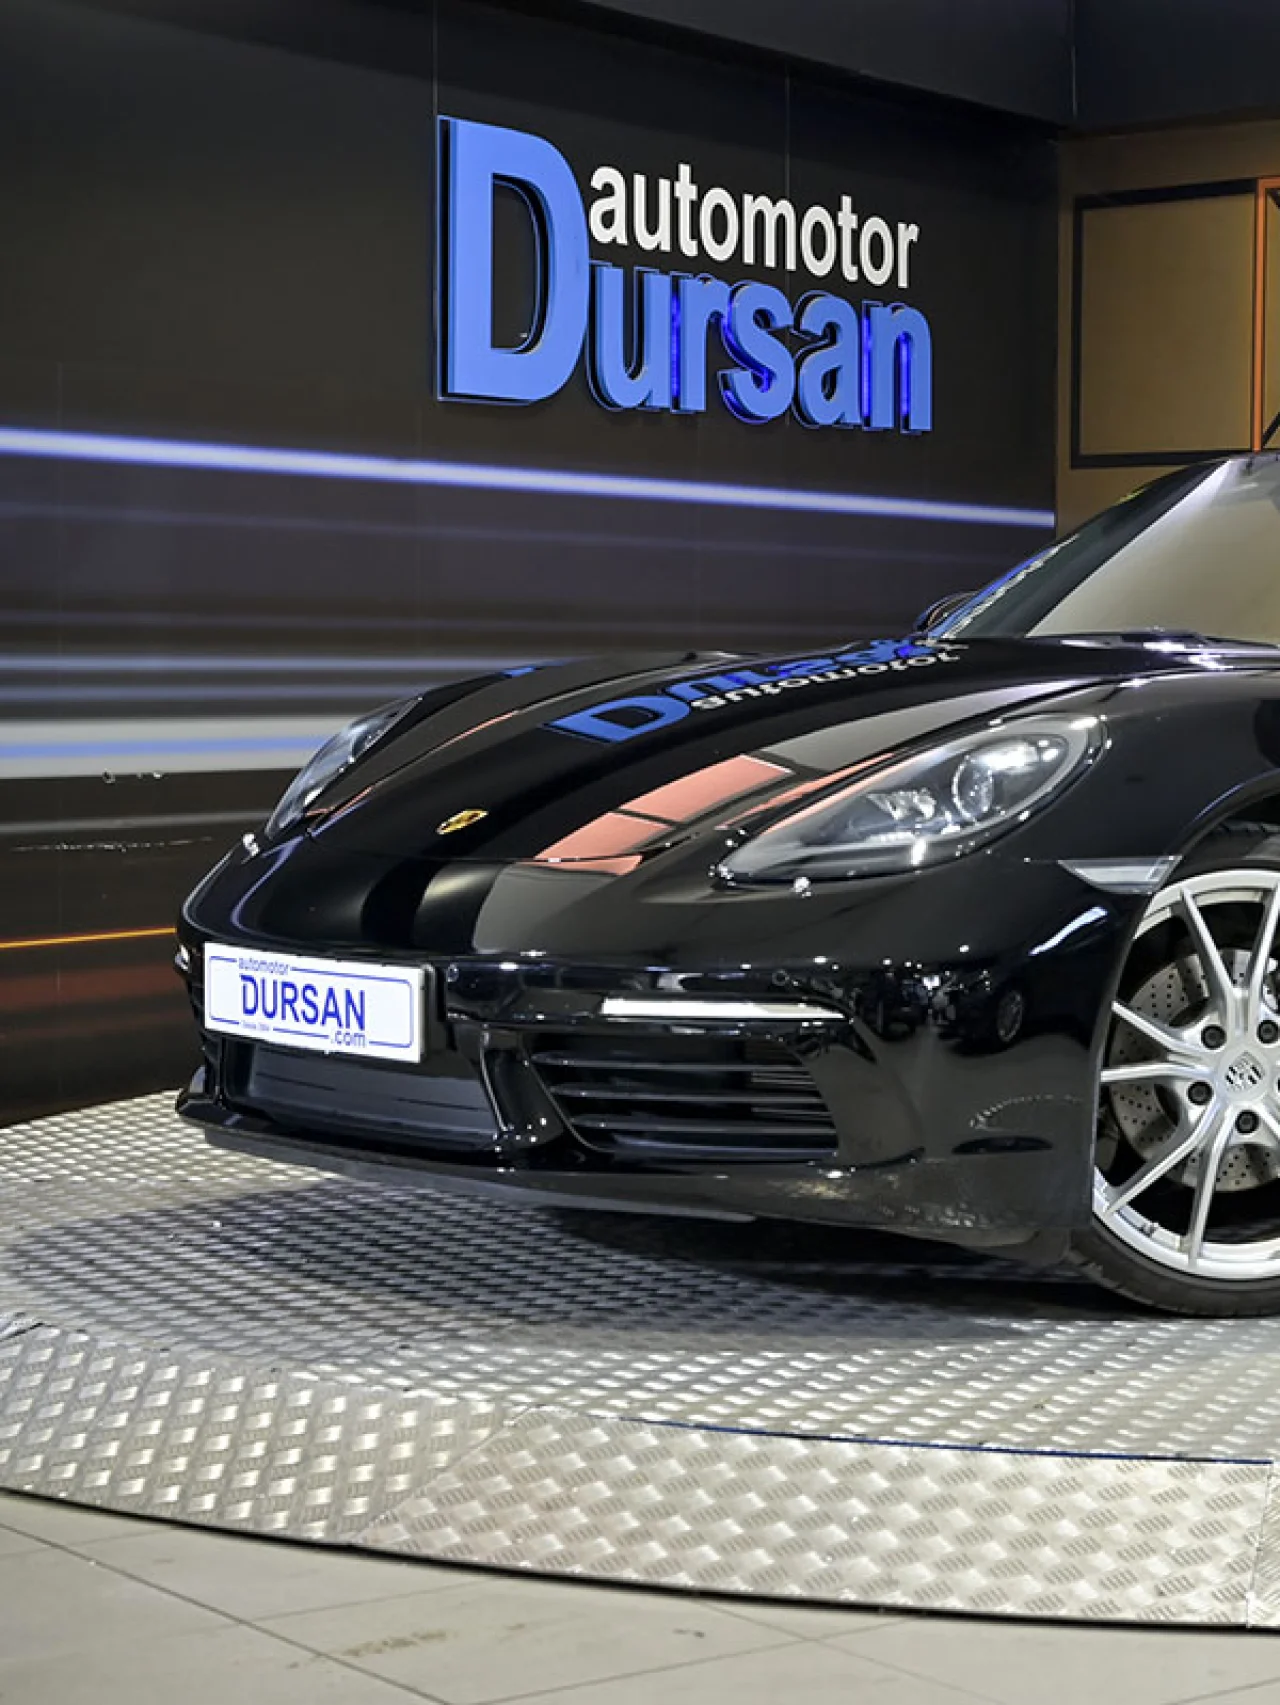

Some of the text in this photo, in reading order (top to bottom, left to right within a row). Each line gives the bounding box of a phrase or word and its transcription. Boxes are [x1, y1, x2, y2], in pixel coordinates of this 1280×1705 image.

[588, 161, 920, 289] automotor
[436, 113, 934, 434] Dursan
[238, 957, 289, 976] automotor
[238, 974, 366, 1032] DURSAN
